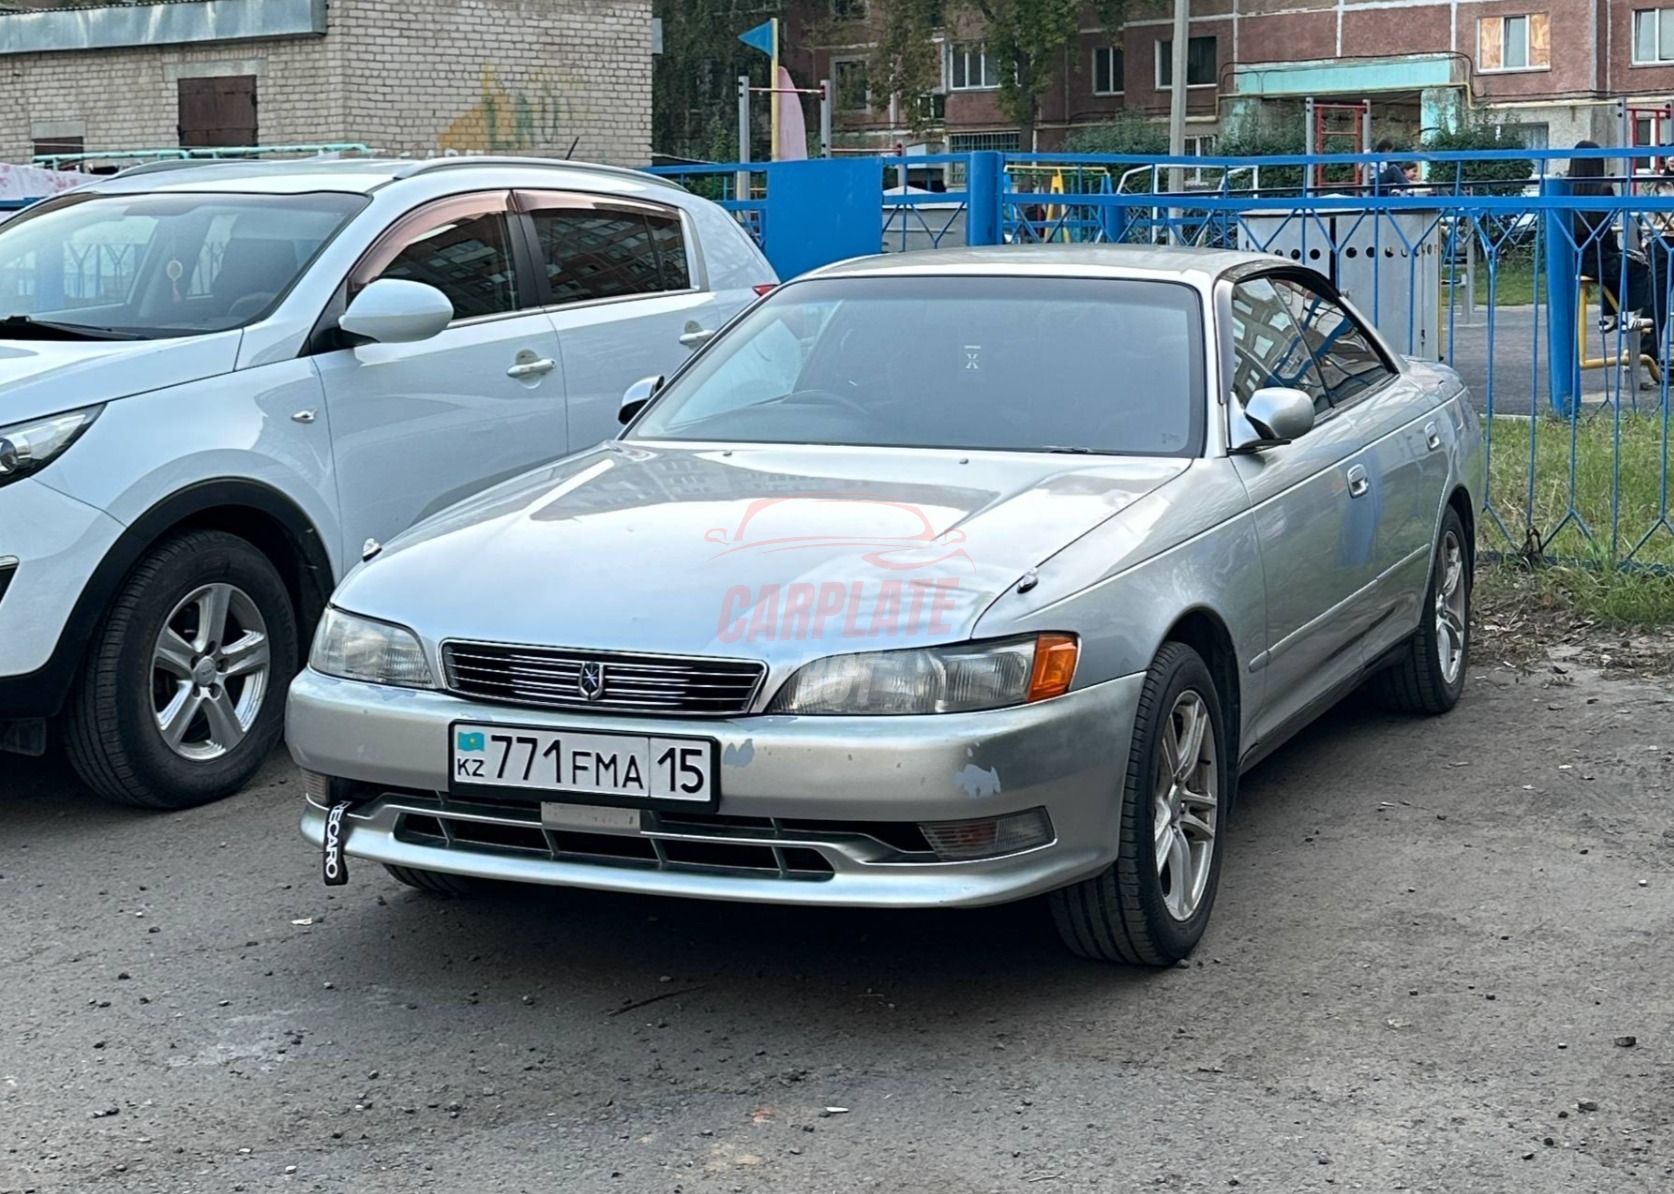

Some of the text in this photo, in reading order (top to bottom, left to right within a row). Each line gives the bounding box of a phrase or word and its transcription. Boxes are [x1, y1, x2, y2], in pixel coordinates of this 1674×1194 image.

[456, 758, 485, 778] KZ
[490, 734, 705, 794] 771 FMA 15
[325, 800, 353, 878] RECARO
